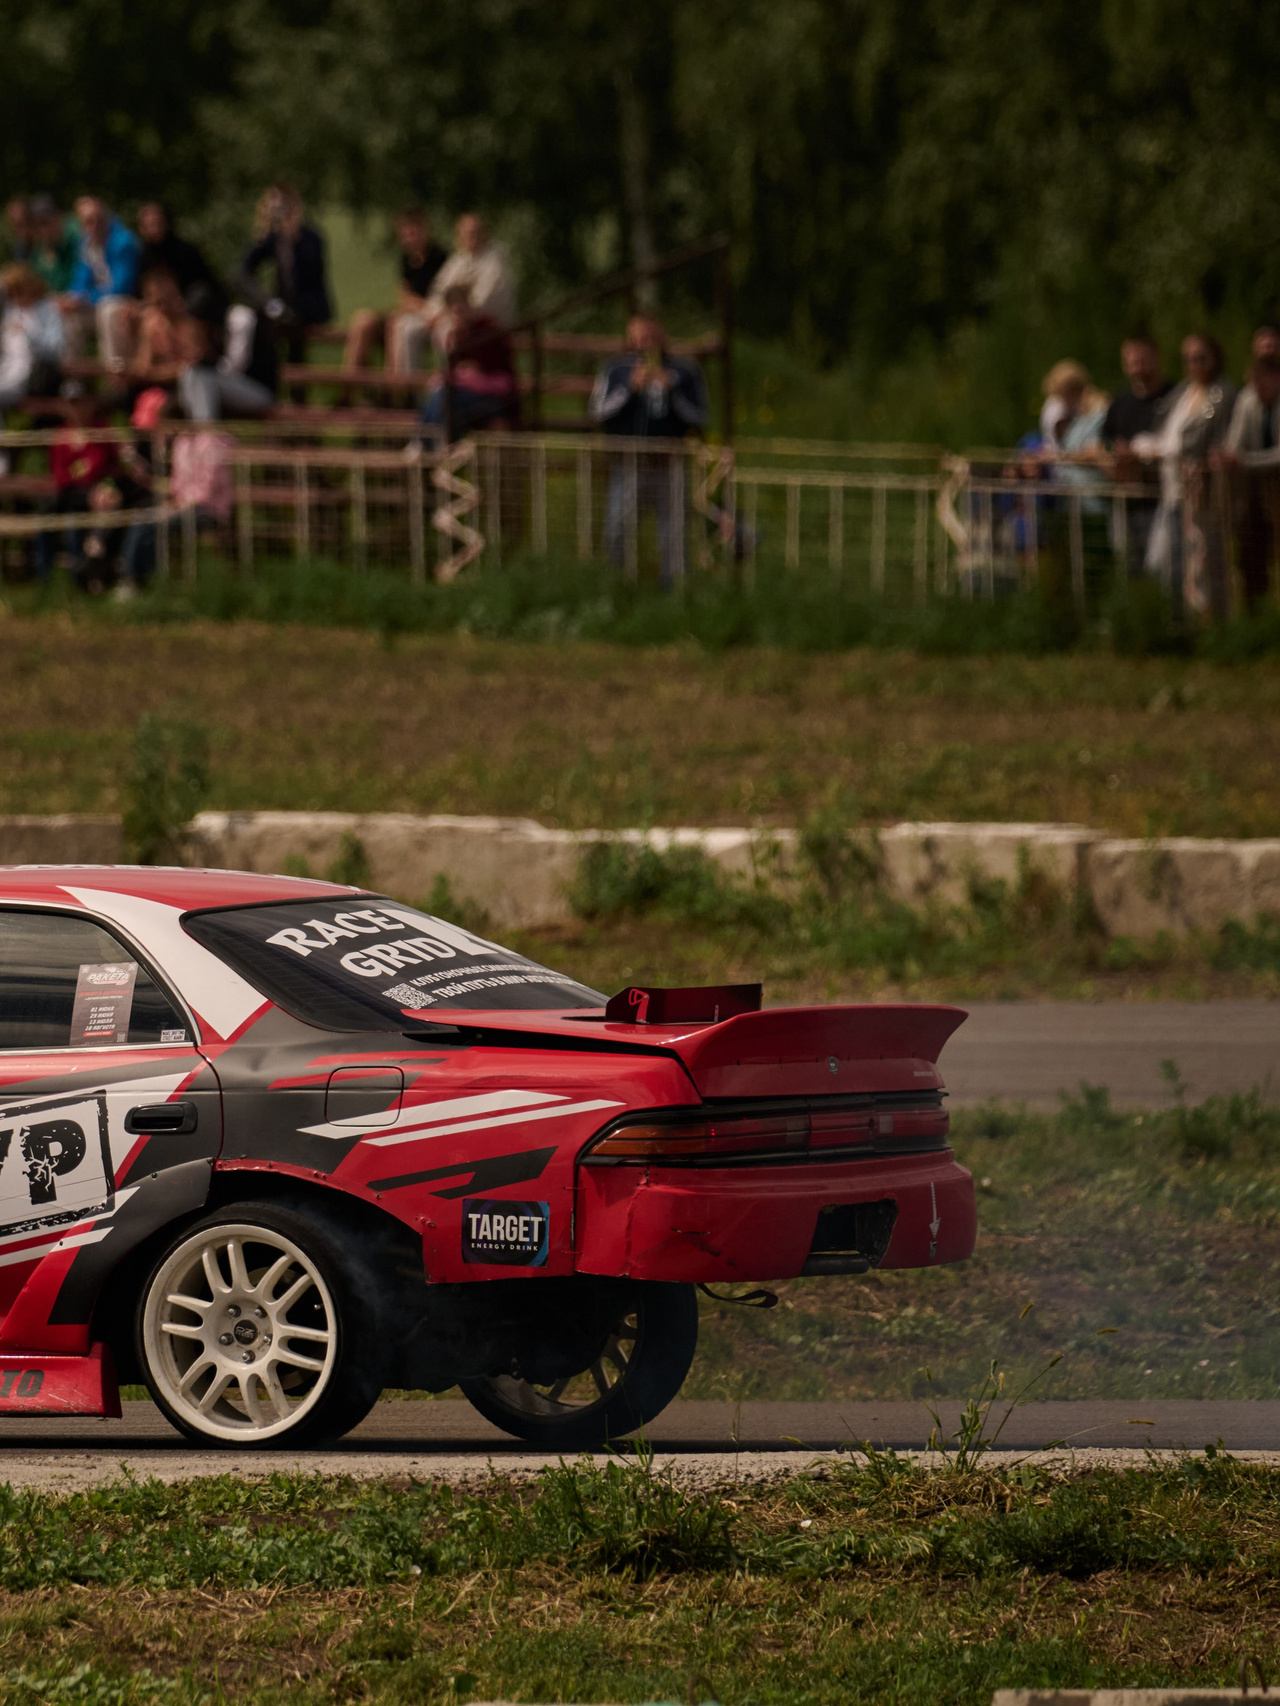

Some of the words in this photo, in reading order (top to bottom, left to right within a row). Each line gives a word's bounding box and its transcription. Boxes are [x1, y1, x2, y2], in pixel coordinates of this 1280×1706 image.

[266, 908, 406, 957] RACE
[340, 937, 457, 977] GRID
[409, 973, 439, 987] КЛУБ
[431, 982, 467, 998] ТВОЙ
[462, 978, 494, 992] ПУТЬ
[468, 1213, 543, 1242] TARGET
[471, 1242, 506, 1250] ENERGY
